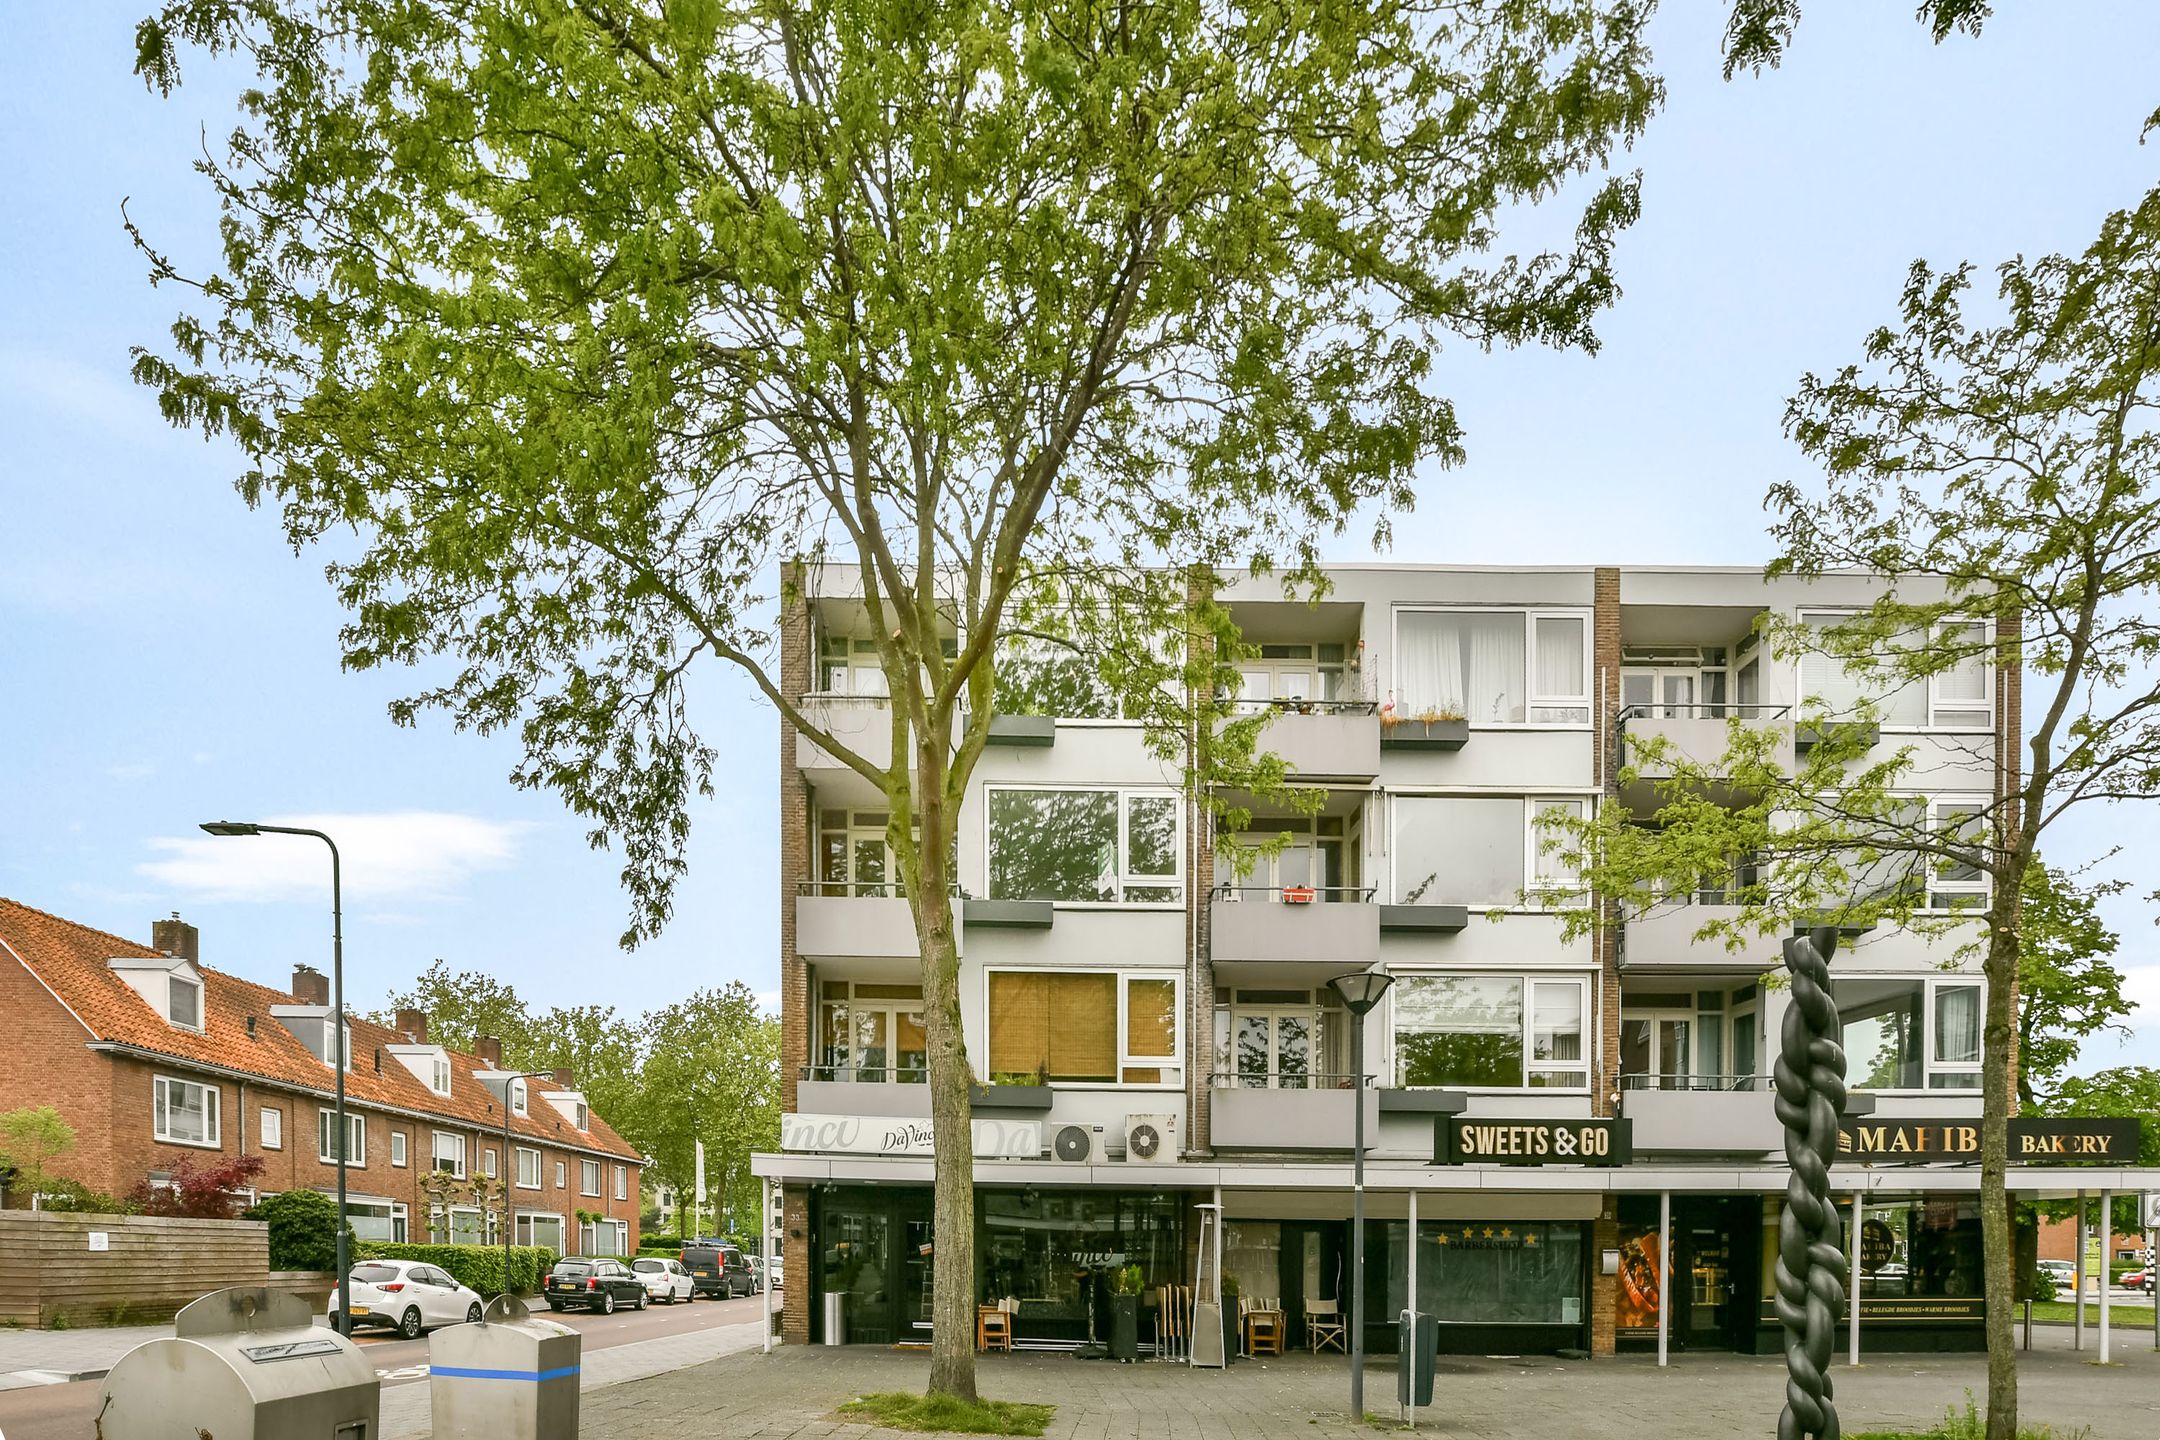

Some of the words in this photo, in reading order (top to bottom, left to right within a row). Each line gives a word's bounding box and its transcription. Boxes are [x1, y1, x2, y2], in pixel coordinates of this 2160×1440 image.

[881, 1124, 935, 1151] DaVinc
[1461, 1125, 1549, 1155] SWEETS
[1580, 1127, 1609, 1156] GO
[1856, 1126, 1983, 1153] MAHIB
[2020, 1135, 2112, 1153] BAKERY
